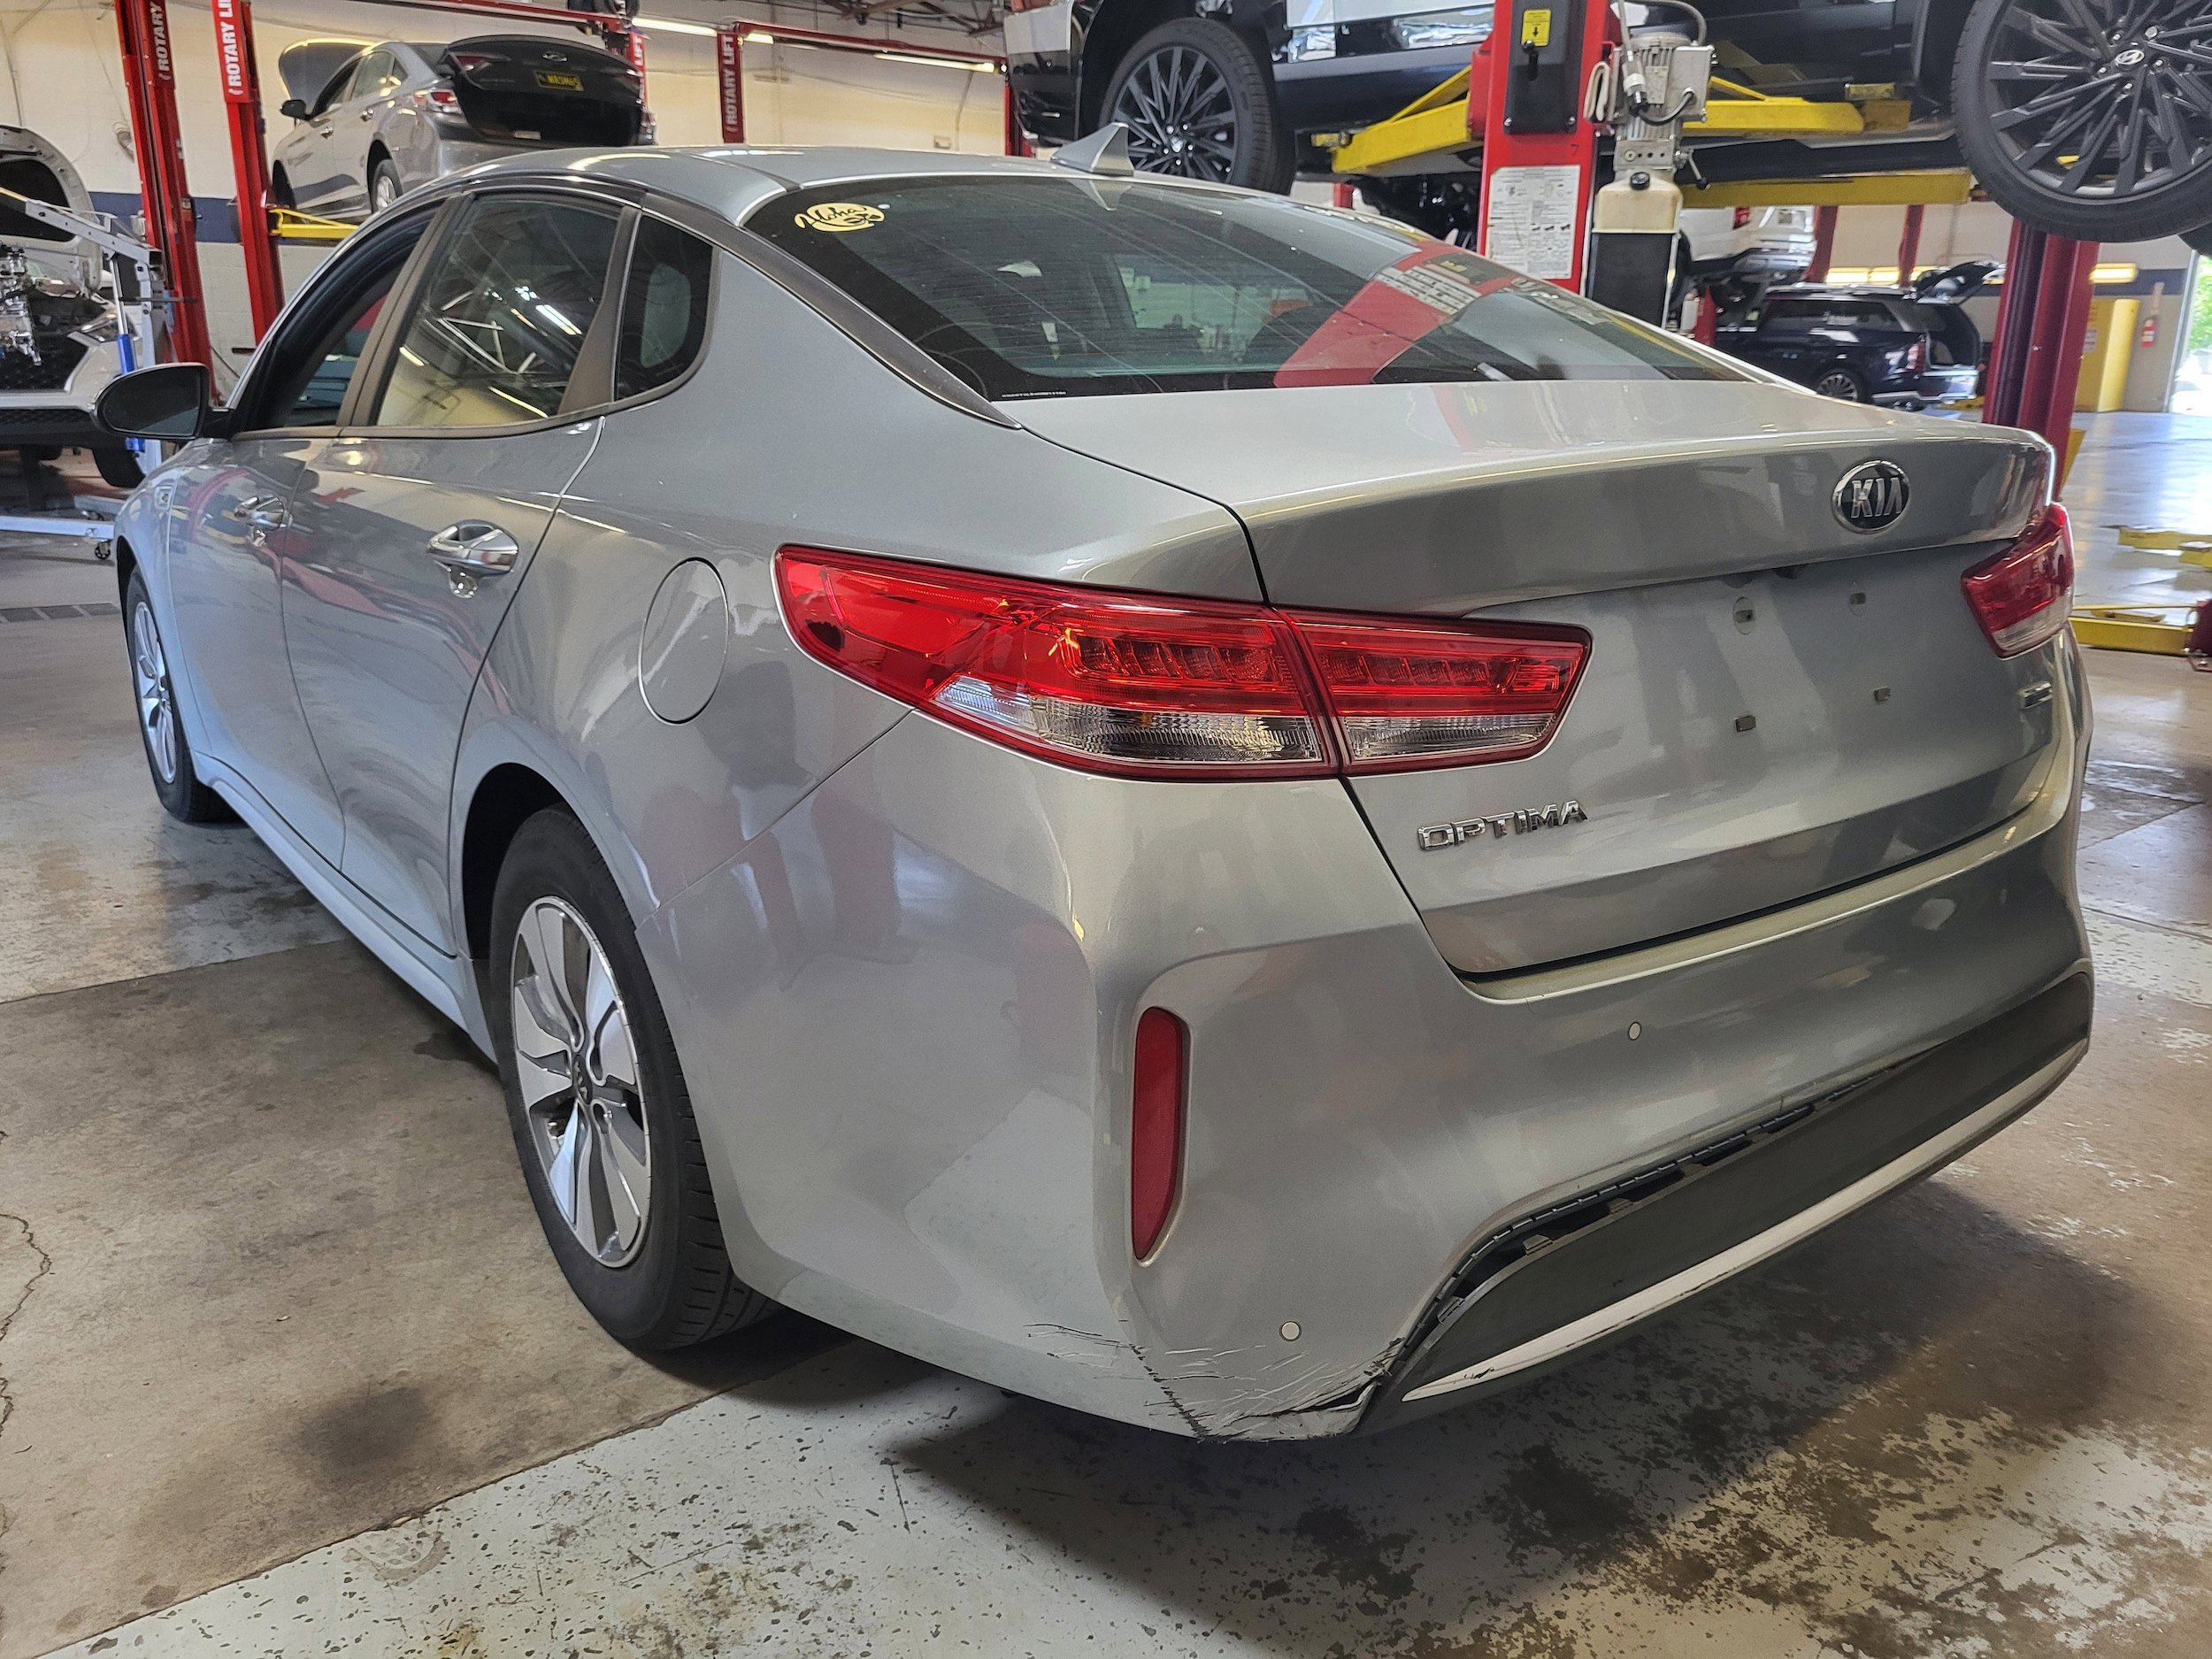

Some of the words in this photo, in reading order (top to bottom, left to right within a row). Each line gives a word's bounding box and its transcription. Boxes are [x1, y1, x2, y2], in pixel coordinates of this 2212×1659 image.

[149, 1, 171, 72] ROTARY
[220, 21, 242, 88] ROTARY
[633, 35, 644, 66] LIFT
[721, 35, 737, 65] LIFT
[723, 69, 739, 126] ROTARY
[1850, 476, 1904, 519] KIA
[1417, 800, 1589, 852] OPTIMA
